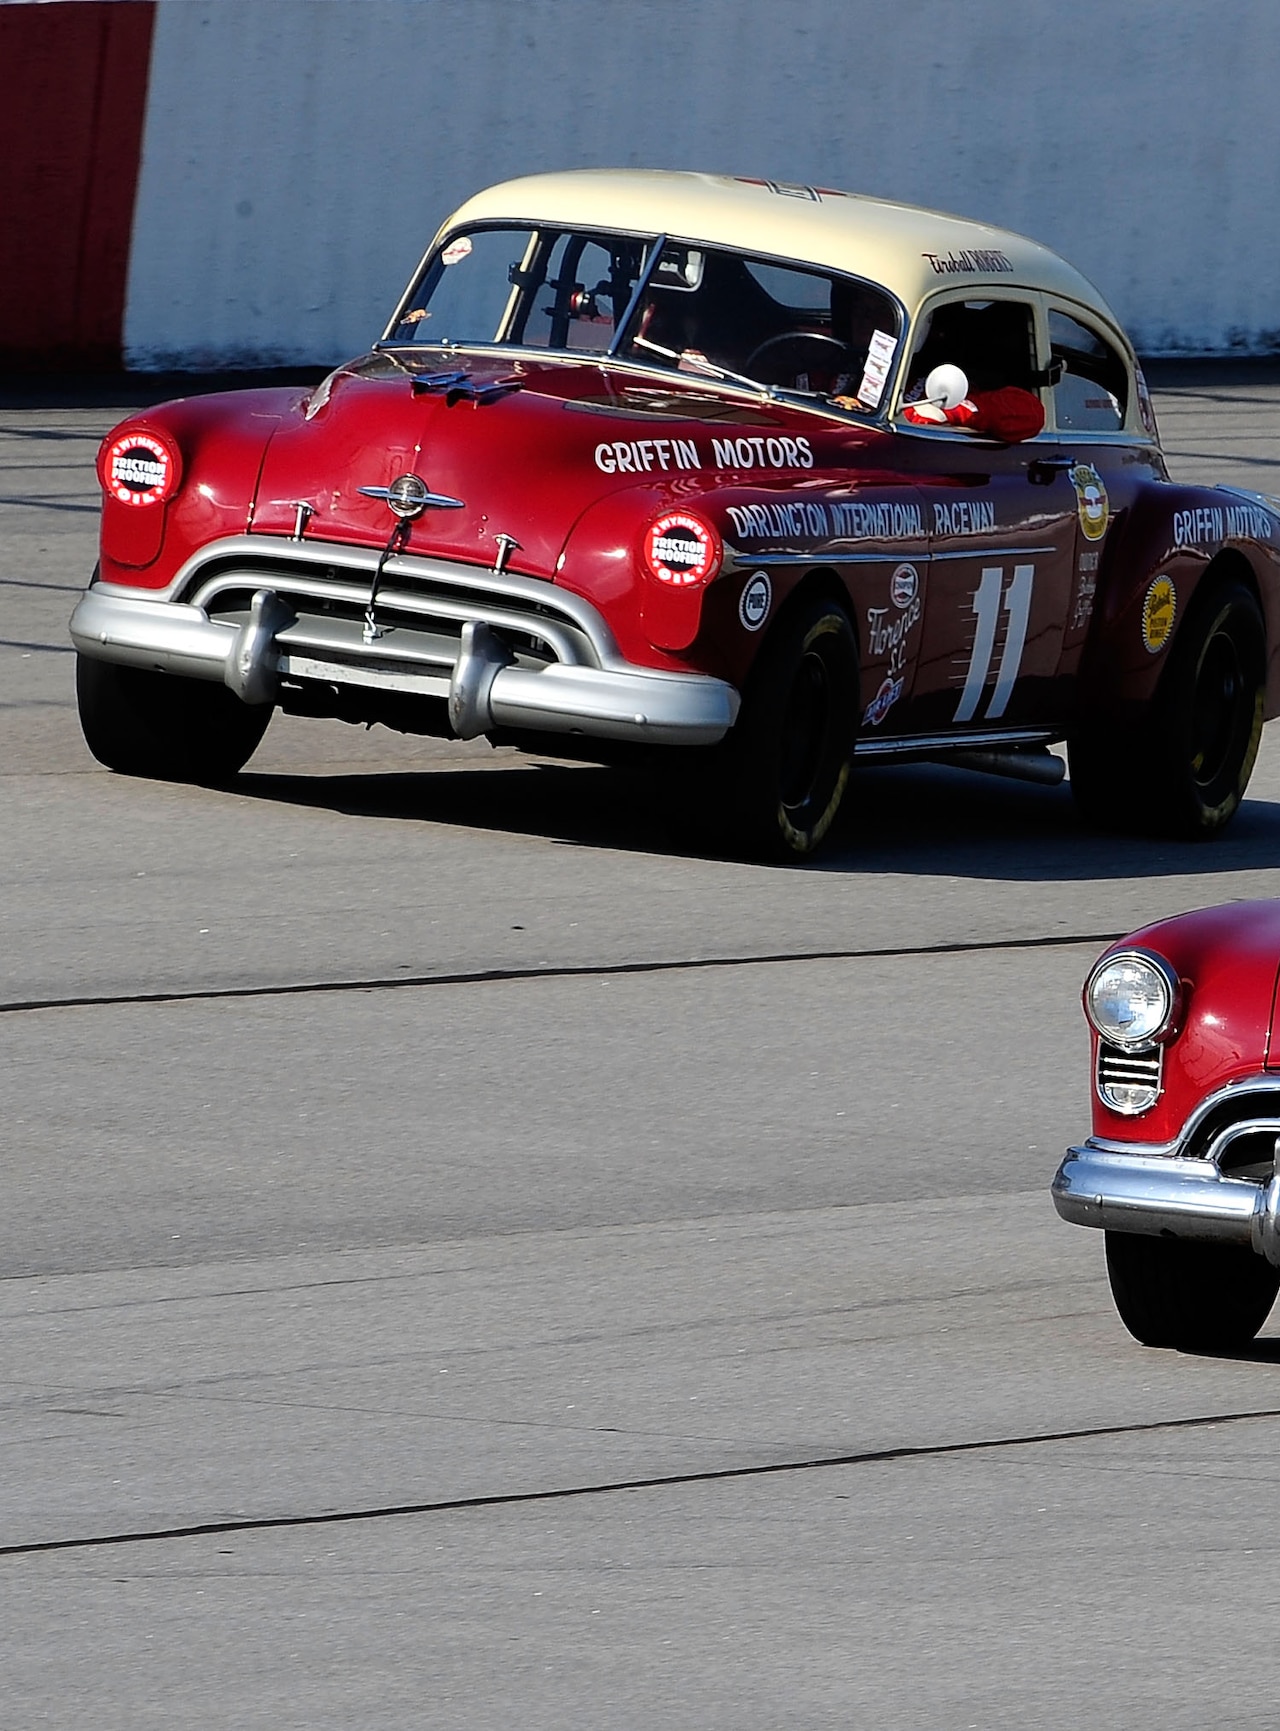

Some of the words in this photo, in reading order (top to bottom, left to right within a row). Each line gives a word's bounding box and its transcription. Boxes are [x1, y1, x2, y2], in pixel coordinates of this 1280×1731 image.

[594, 439, 702, 474] GRIFFIN
[711, 436, 815, 470] MOTORS
[112, 456, 167, 475] FRICTION
[111, 467, 166, 487] PROOFING
[117, 487, 156, 505] OIL
[725, 502, 829, 539] DARLINGTON
[831, 501, 925, 537] INTERNATIONAL
[932, 501, 997, 536] RACEWAY
[1172, 505, 1224, 546] GRIFFIN
[1225, 505, 1273, 539] MOTORS
[652, 536, 707, 554] FRICTION
[651, 547, 706, 567] PROOFING
[657, 567, 696, 584] OIL
[950, 564, 1035, 722] 11
